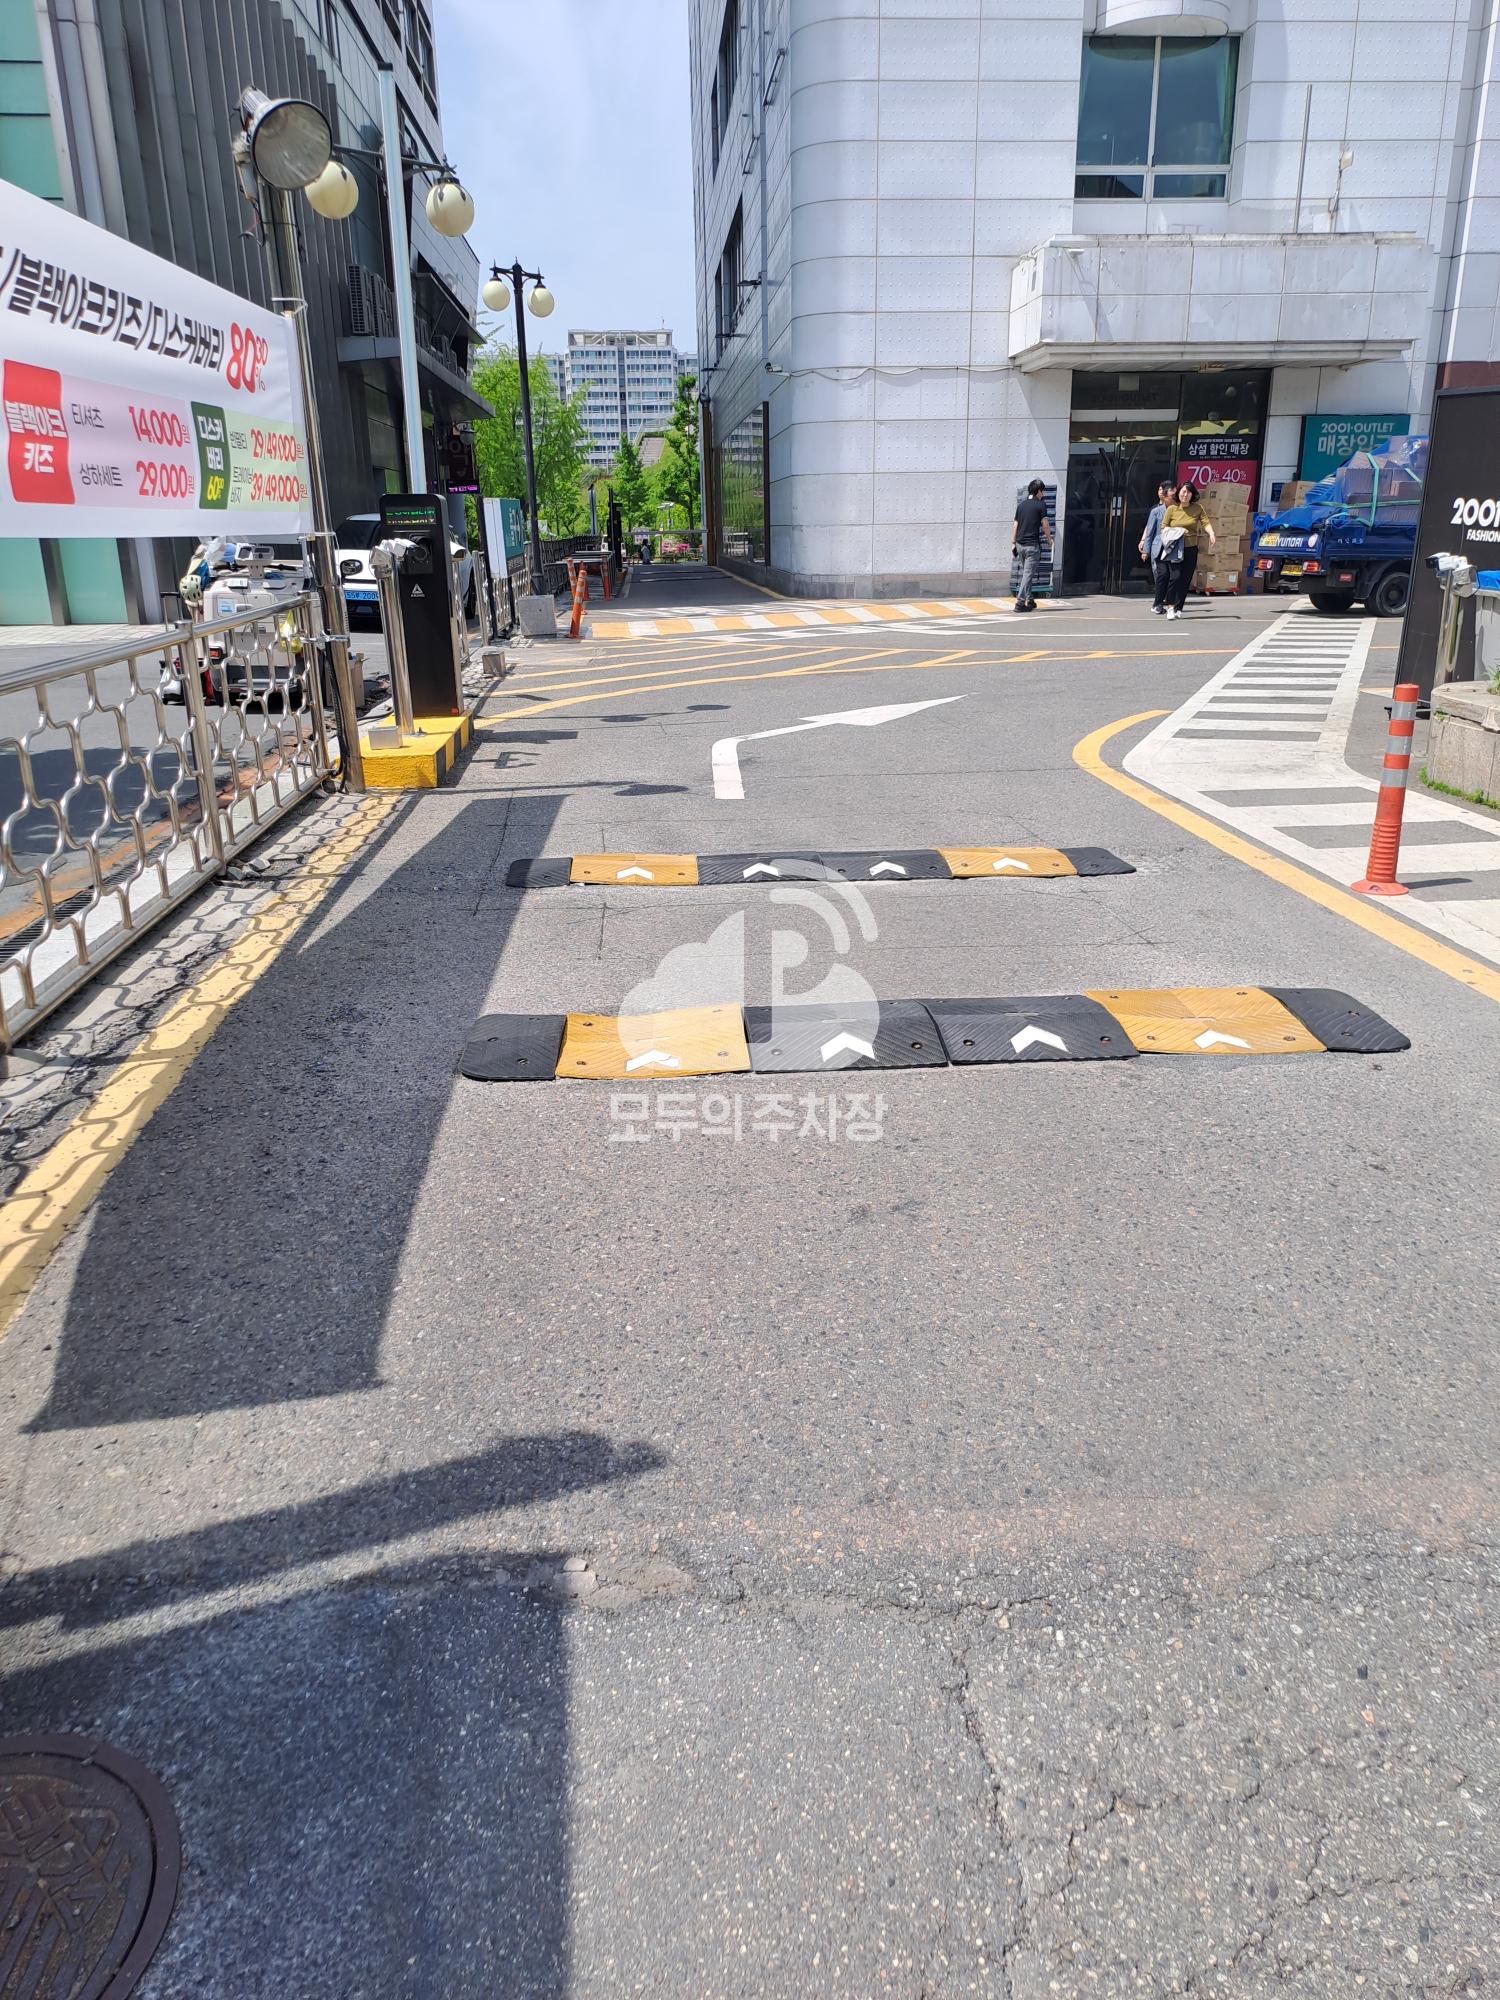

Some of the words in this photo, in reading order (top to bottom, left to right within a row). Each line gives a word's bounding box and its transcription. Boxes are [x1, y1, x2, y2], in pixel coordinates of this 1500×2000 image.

[0, 246, 224, 372] /블랙야크키즈/디스커버리
[71, 403, 105, 428] 티셔츠
[197, 415, 225, 442] 디스커
[24, 442, 55, 473] 키즈
[206, 446, 224, 471] 버리
[1188, 443, 1207, 456] 상설
[1210, 443, 1228, 455] 할인
[1230, 443, 1249, 455] 매장
[80, 463, 124, 487] 상하세트
[1274, 535, 1303, 547] YUNDAI
